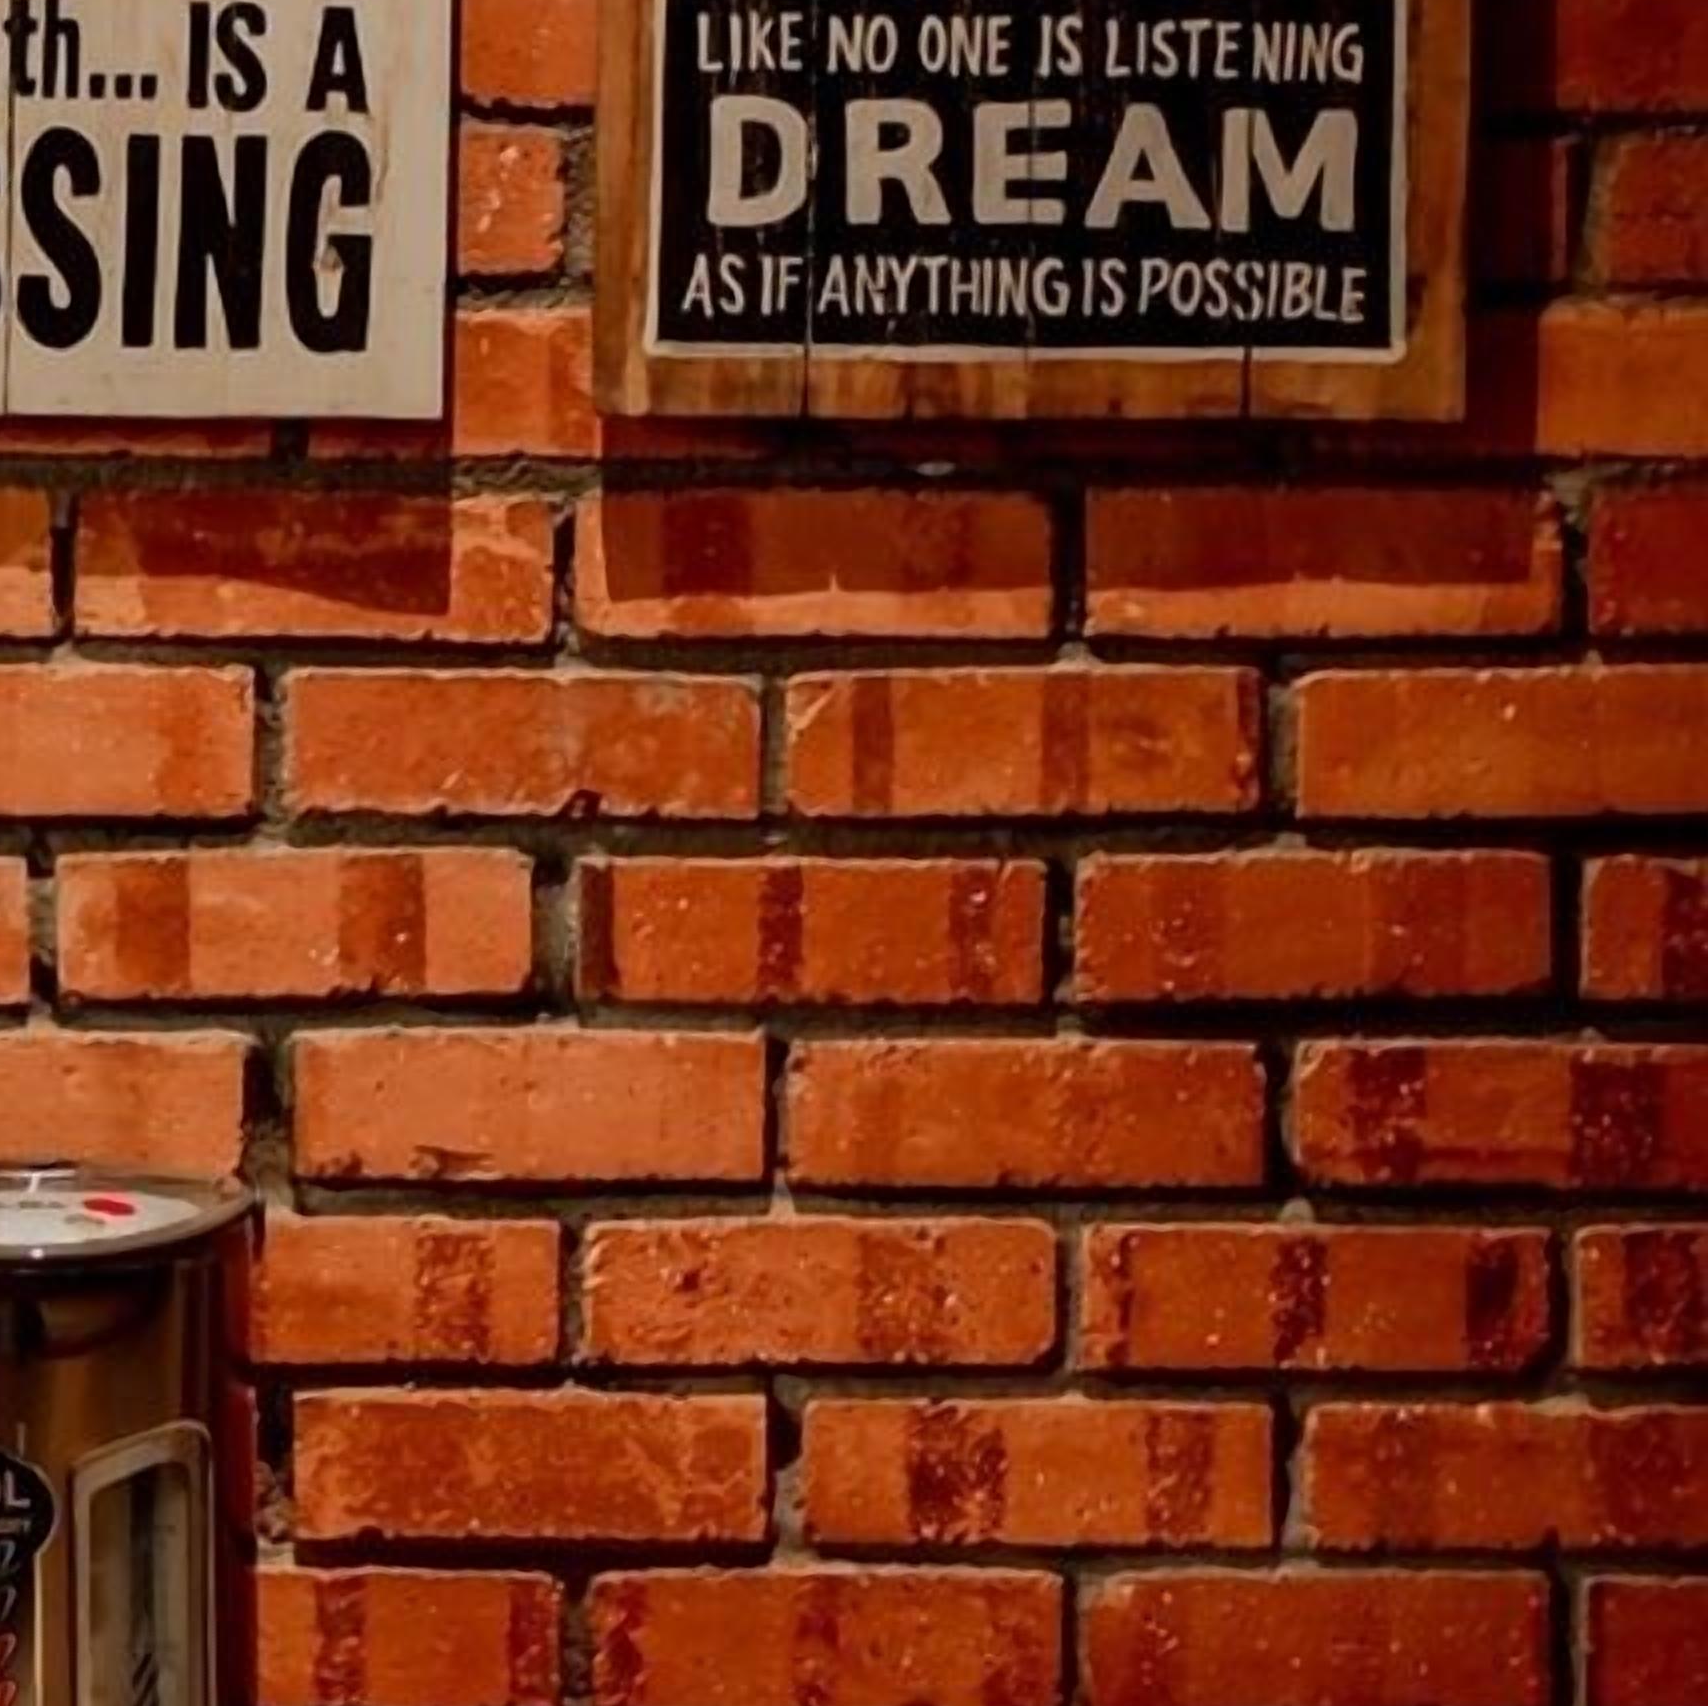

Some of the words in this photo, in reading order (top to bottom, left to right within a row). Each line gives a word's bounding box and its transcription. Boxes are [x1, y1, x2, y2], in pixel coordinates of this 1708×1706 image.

[188, 1, 269, 112] IS
[309, 5, 368, 114] A
[697, 12, 804, 74] LIKE
[827, 15, 898, 76] NO
[918, 14, 1012, 77] ONE
[1039, 15, 1085, 78] IS
[707, 95, 1359, 232] DREAM
[683, 254, 746, 314] AS
[760, 256, 809, 315] IF
[819, 256, 1071, 319] ANYTHING
[1086, 259, 1124, 319] IS
[1138, 259, 1366, 325] POSSIBLE
